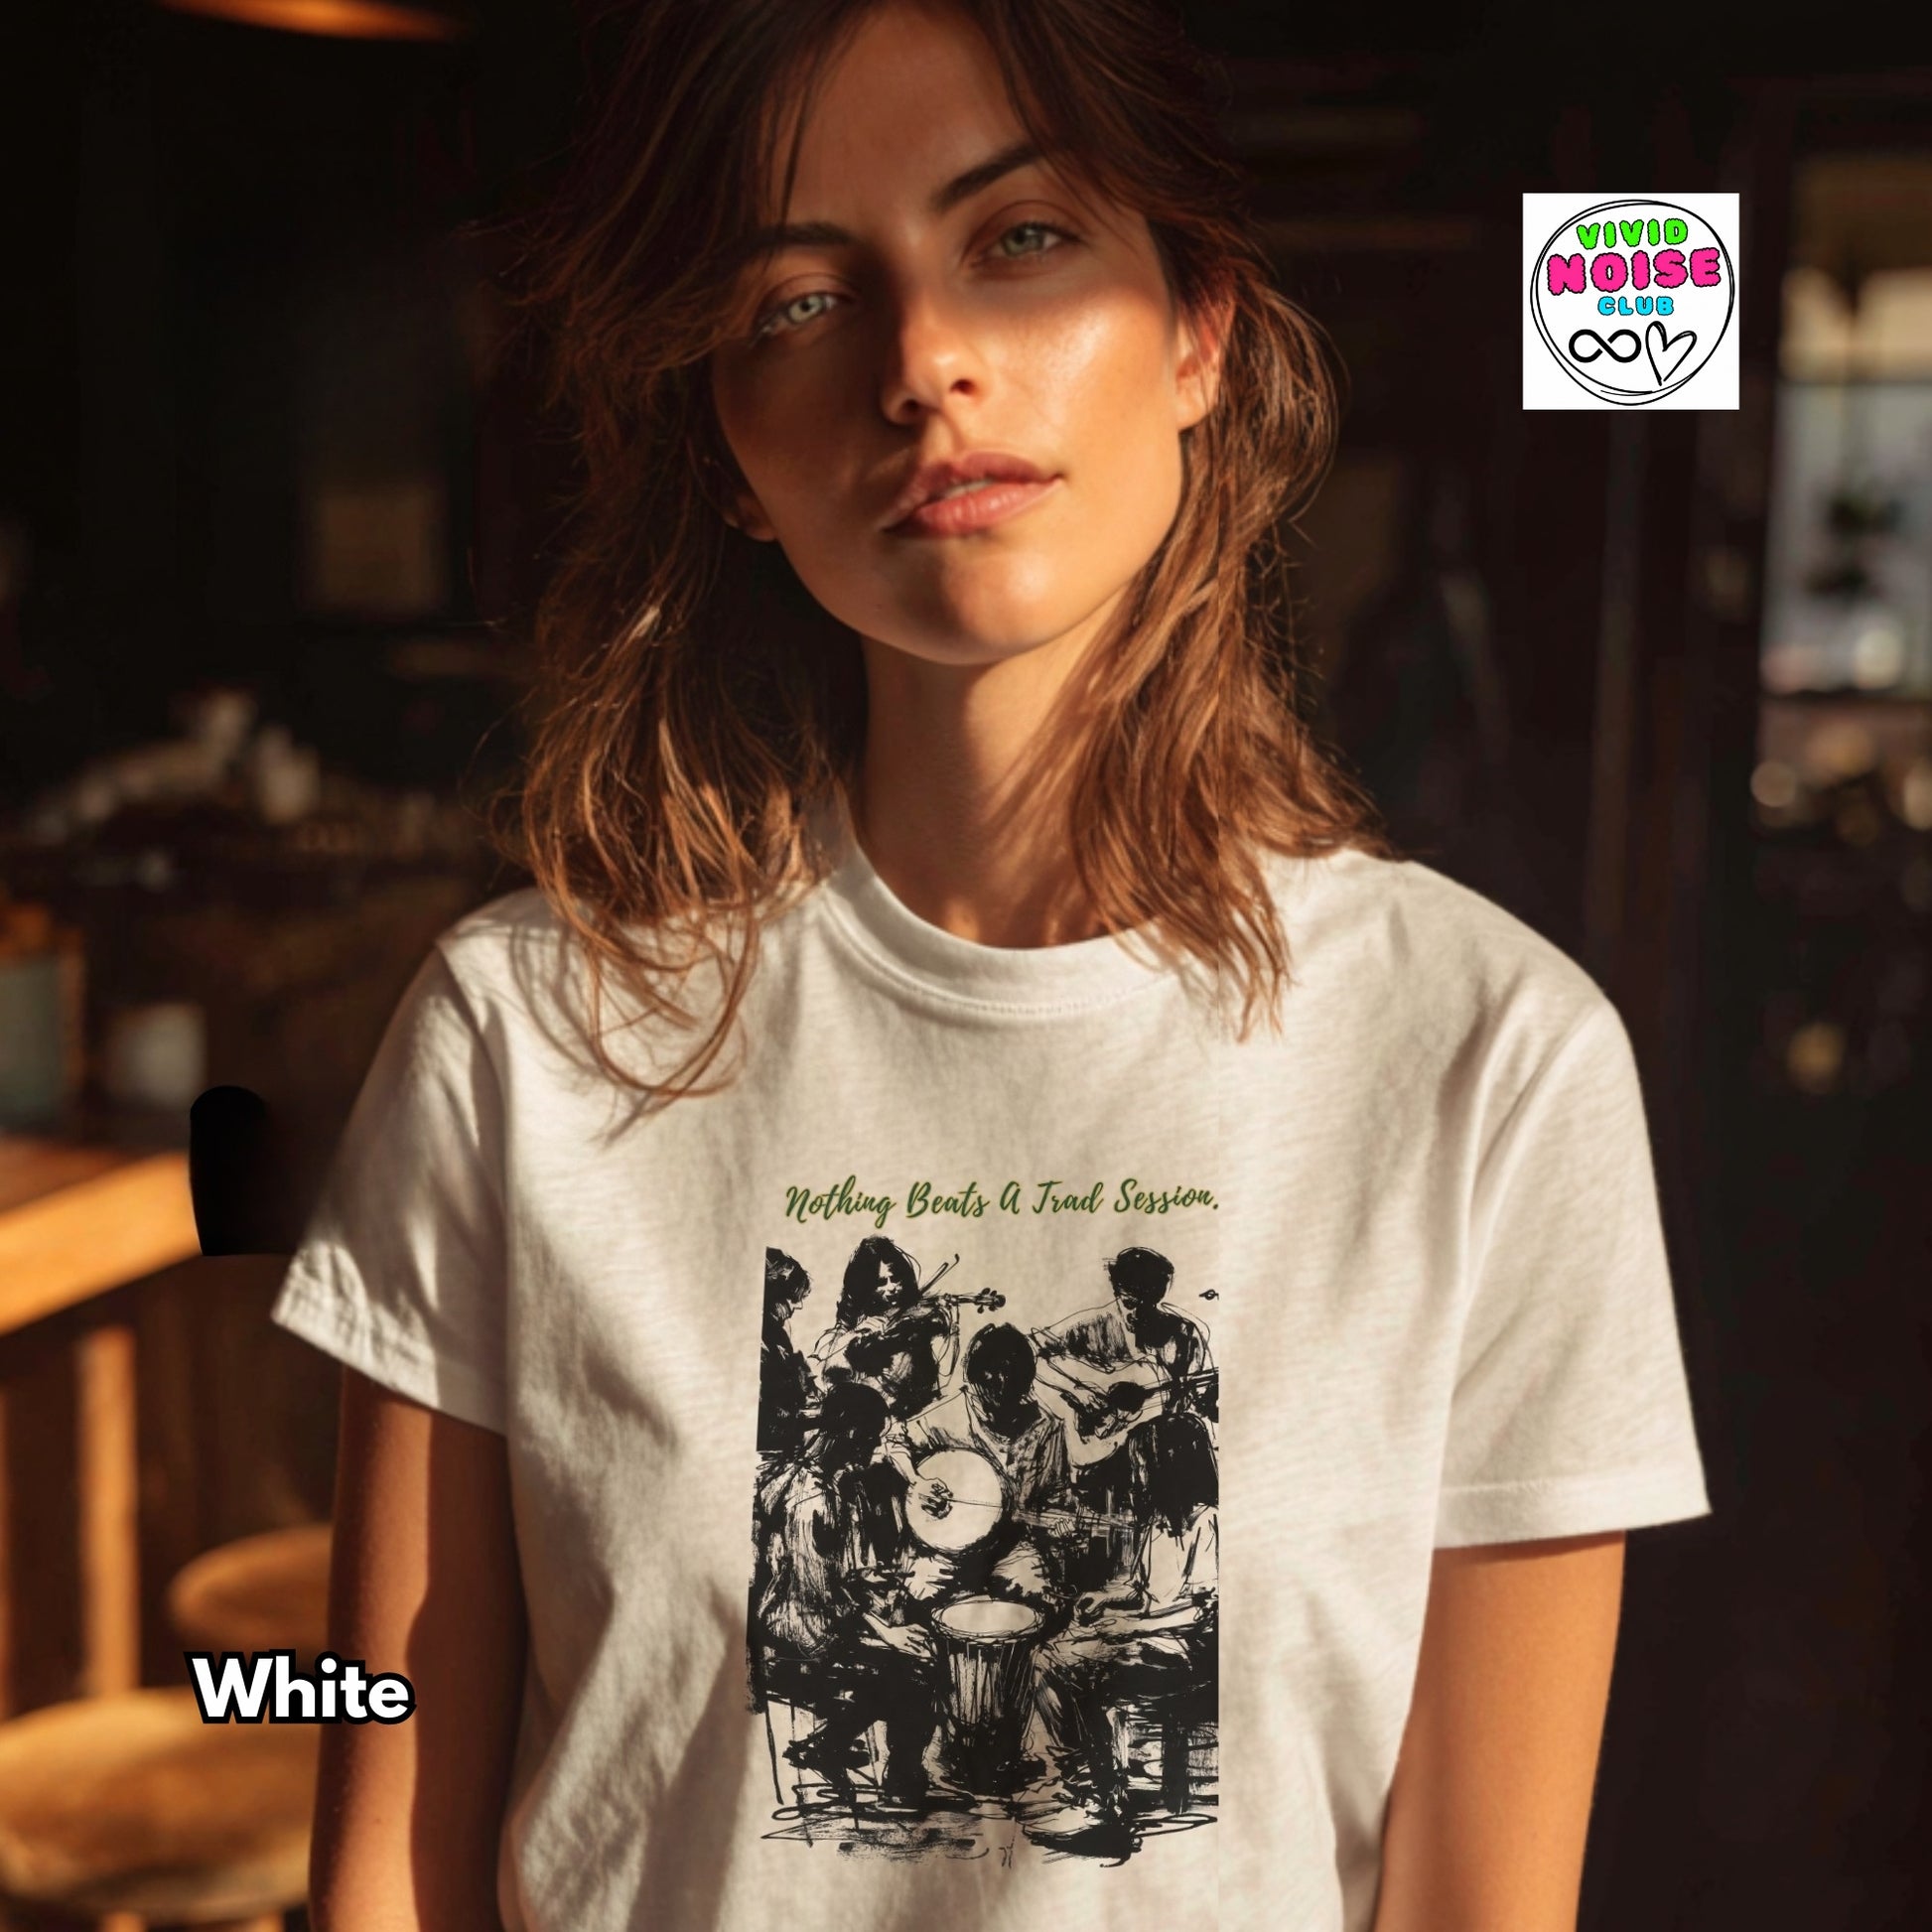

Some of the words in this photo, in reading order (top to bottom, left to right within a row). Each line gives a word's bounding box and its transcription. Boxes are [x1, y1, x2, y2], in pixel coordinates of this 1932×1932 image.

[785, 1174, 897, 1229] Nothing
[905, 1180, 991, 1219] Beats
[999, 1180, 1022, 1215] A
[1032, 1179, 1105, 1215] Trad
[1113, 1177, 1220, 1214] Session.
